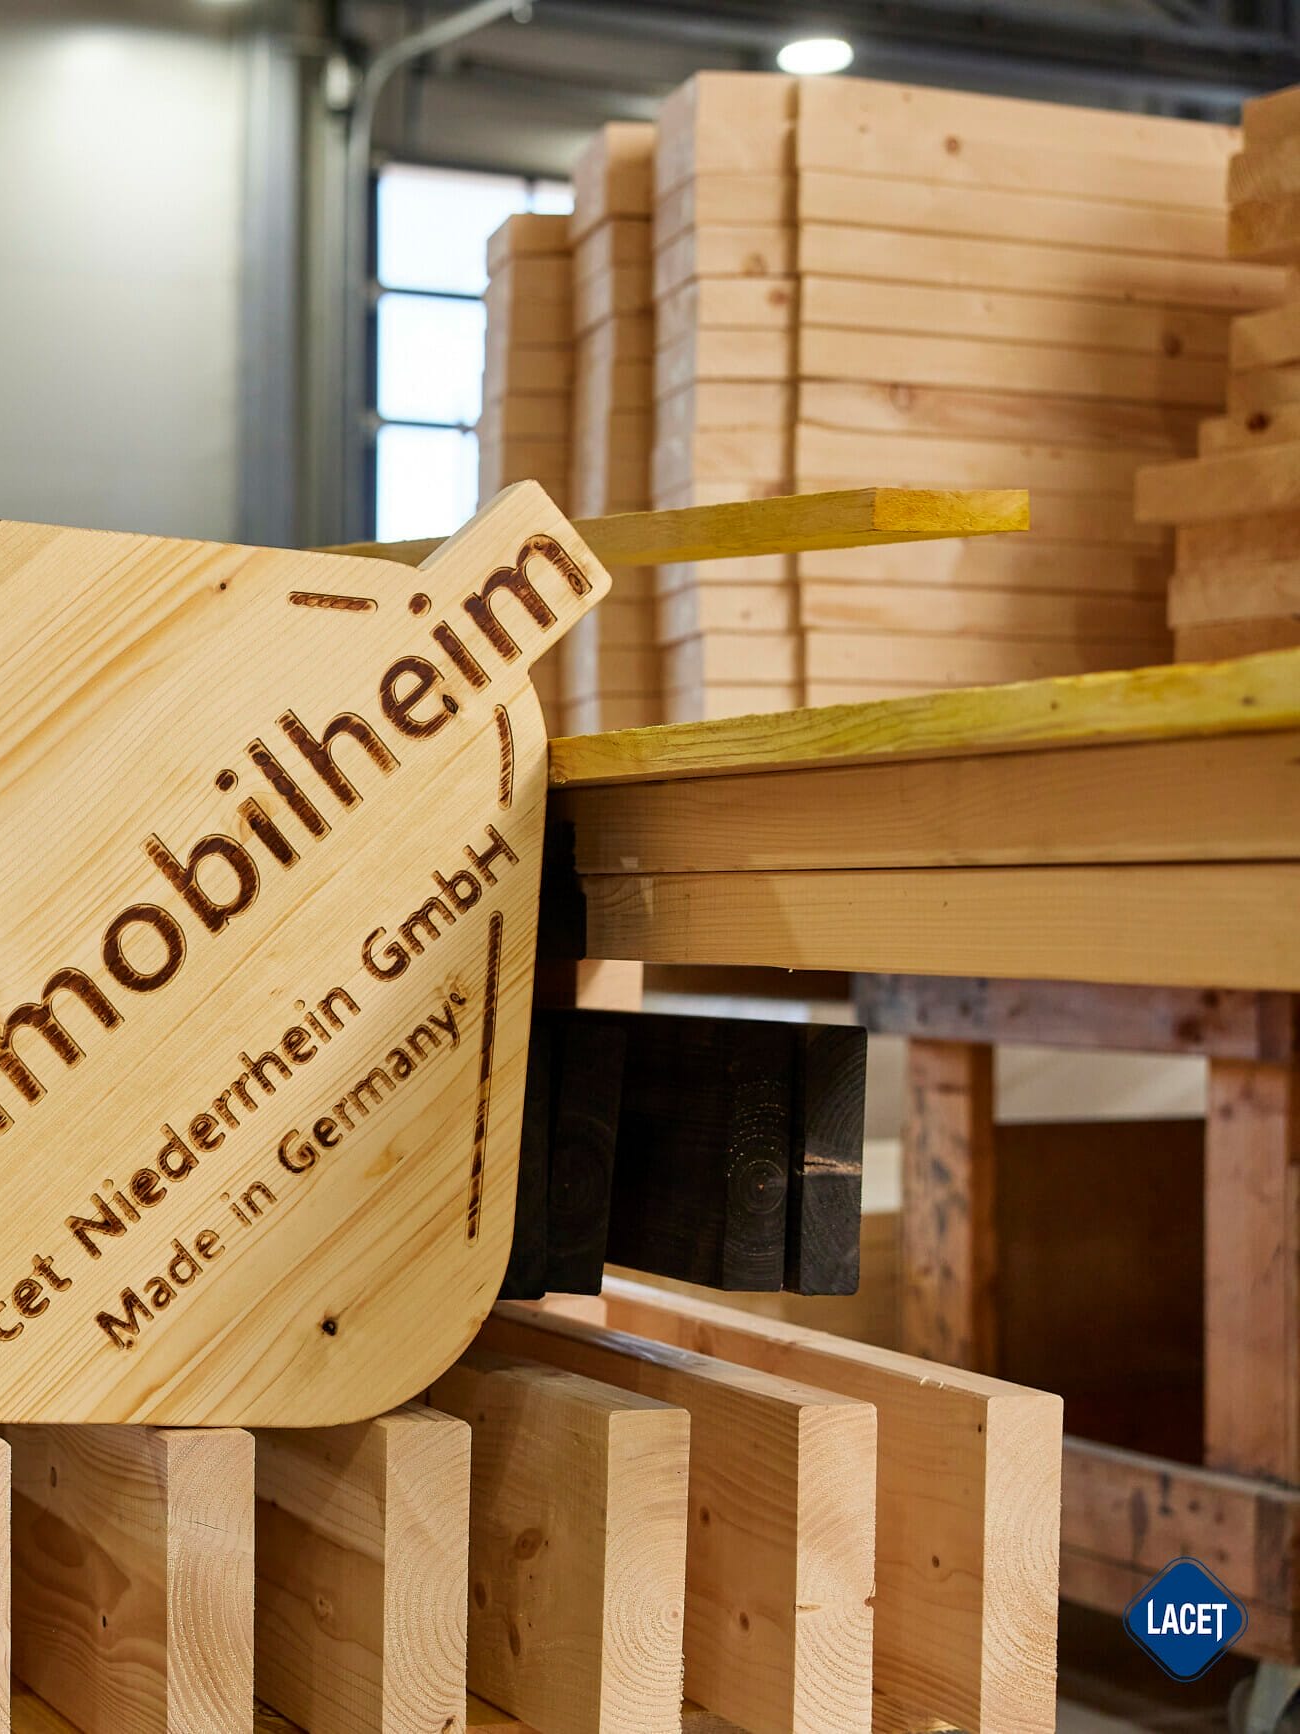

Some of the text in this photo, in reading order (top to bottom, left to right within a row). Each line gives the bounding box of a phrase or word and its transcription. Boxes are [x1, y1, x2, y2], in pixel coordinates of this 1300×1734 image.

[64, 986, 361, 1260] Niederrhein
[362, 823, 520, 983] GmbH
[95, 1001, 460, 1350] Made in Germany
